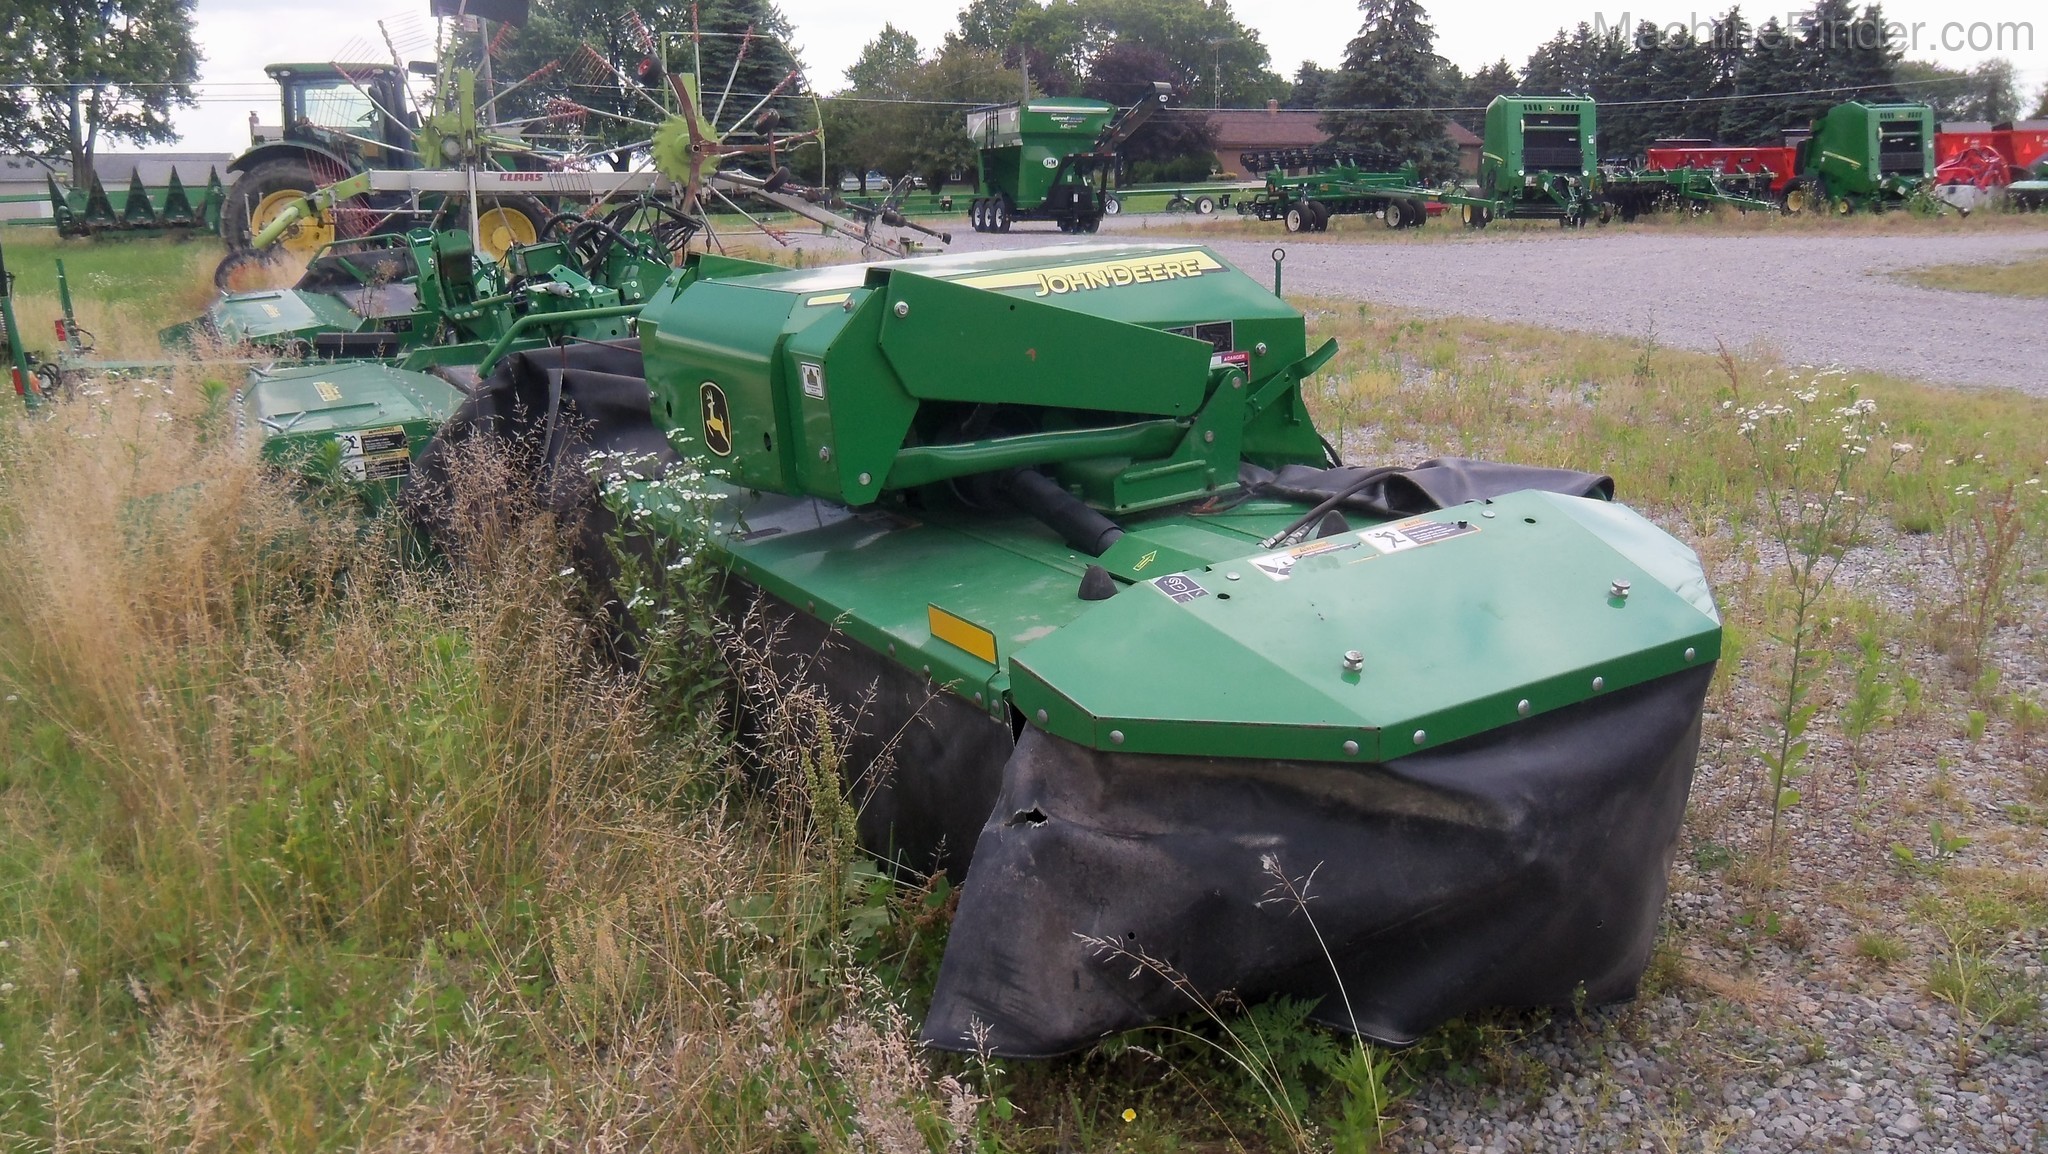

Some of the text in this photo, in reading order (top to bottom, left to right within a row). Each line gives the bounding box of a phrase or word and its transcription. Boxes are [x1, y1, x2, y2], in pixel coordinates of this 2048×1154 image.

[500, 173, 543, 182] CLAAS
[1034, 259, 1202, 297] JOHN DEERE
